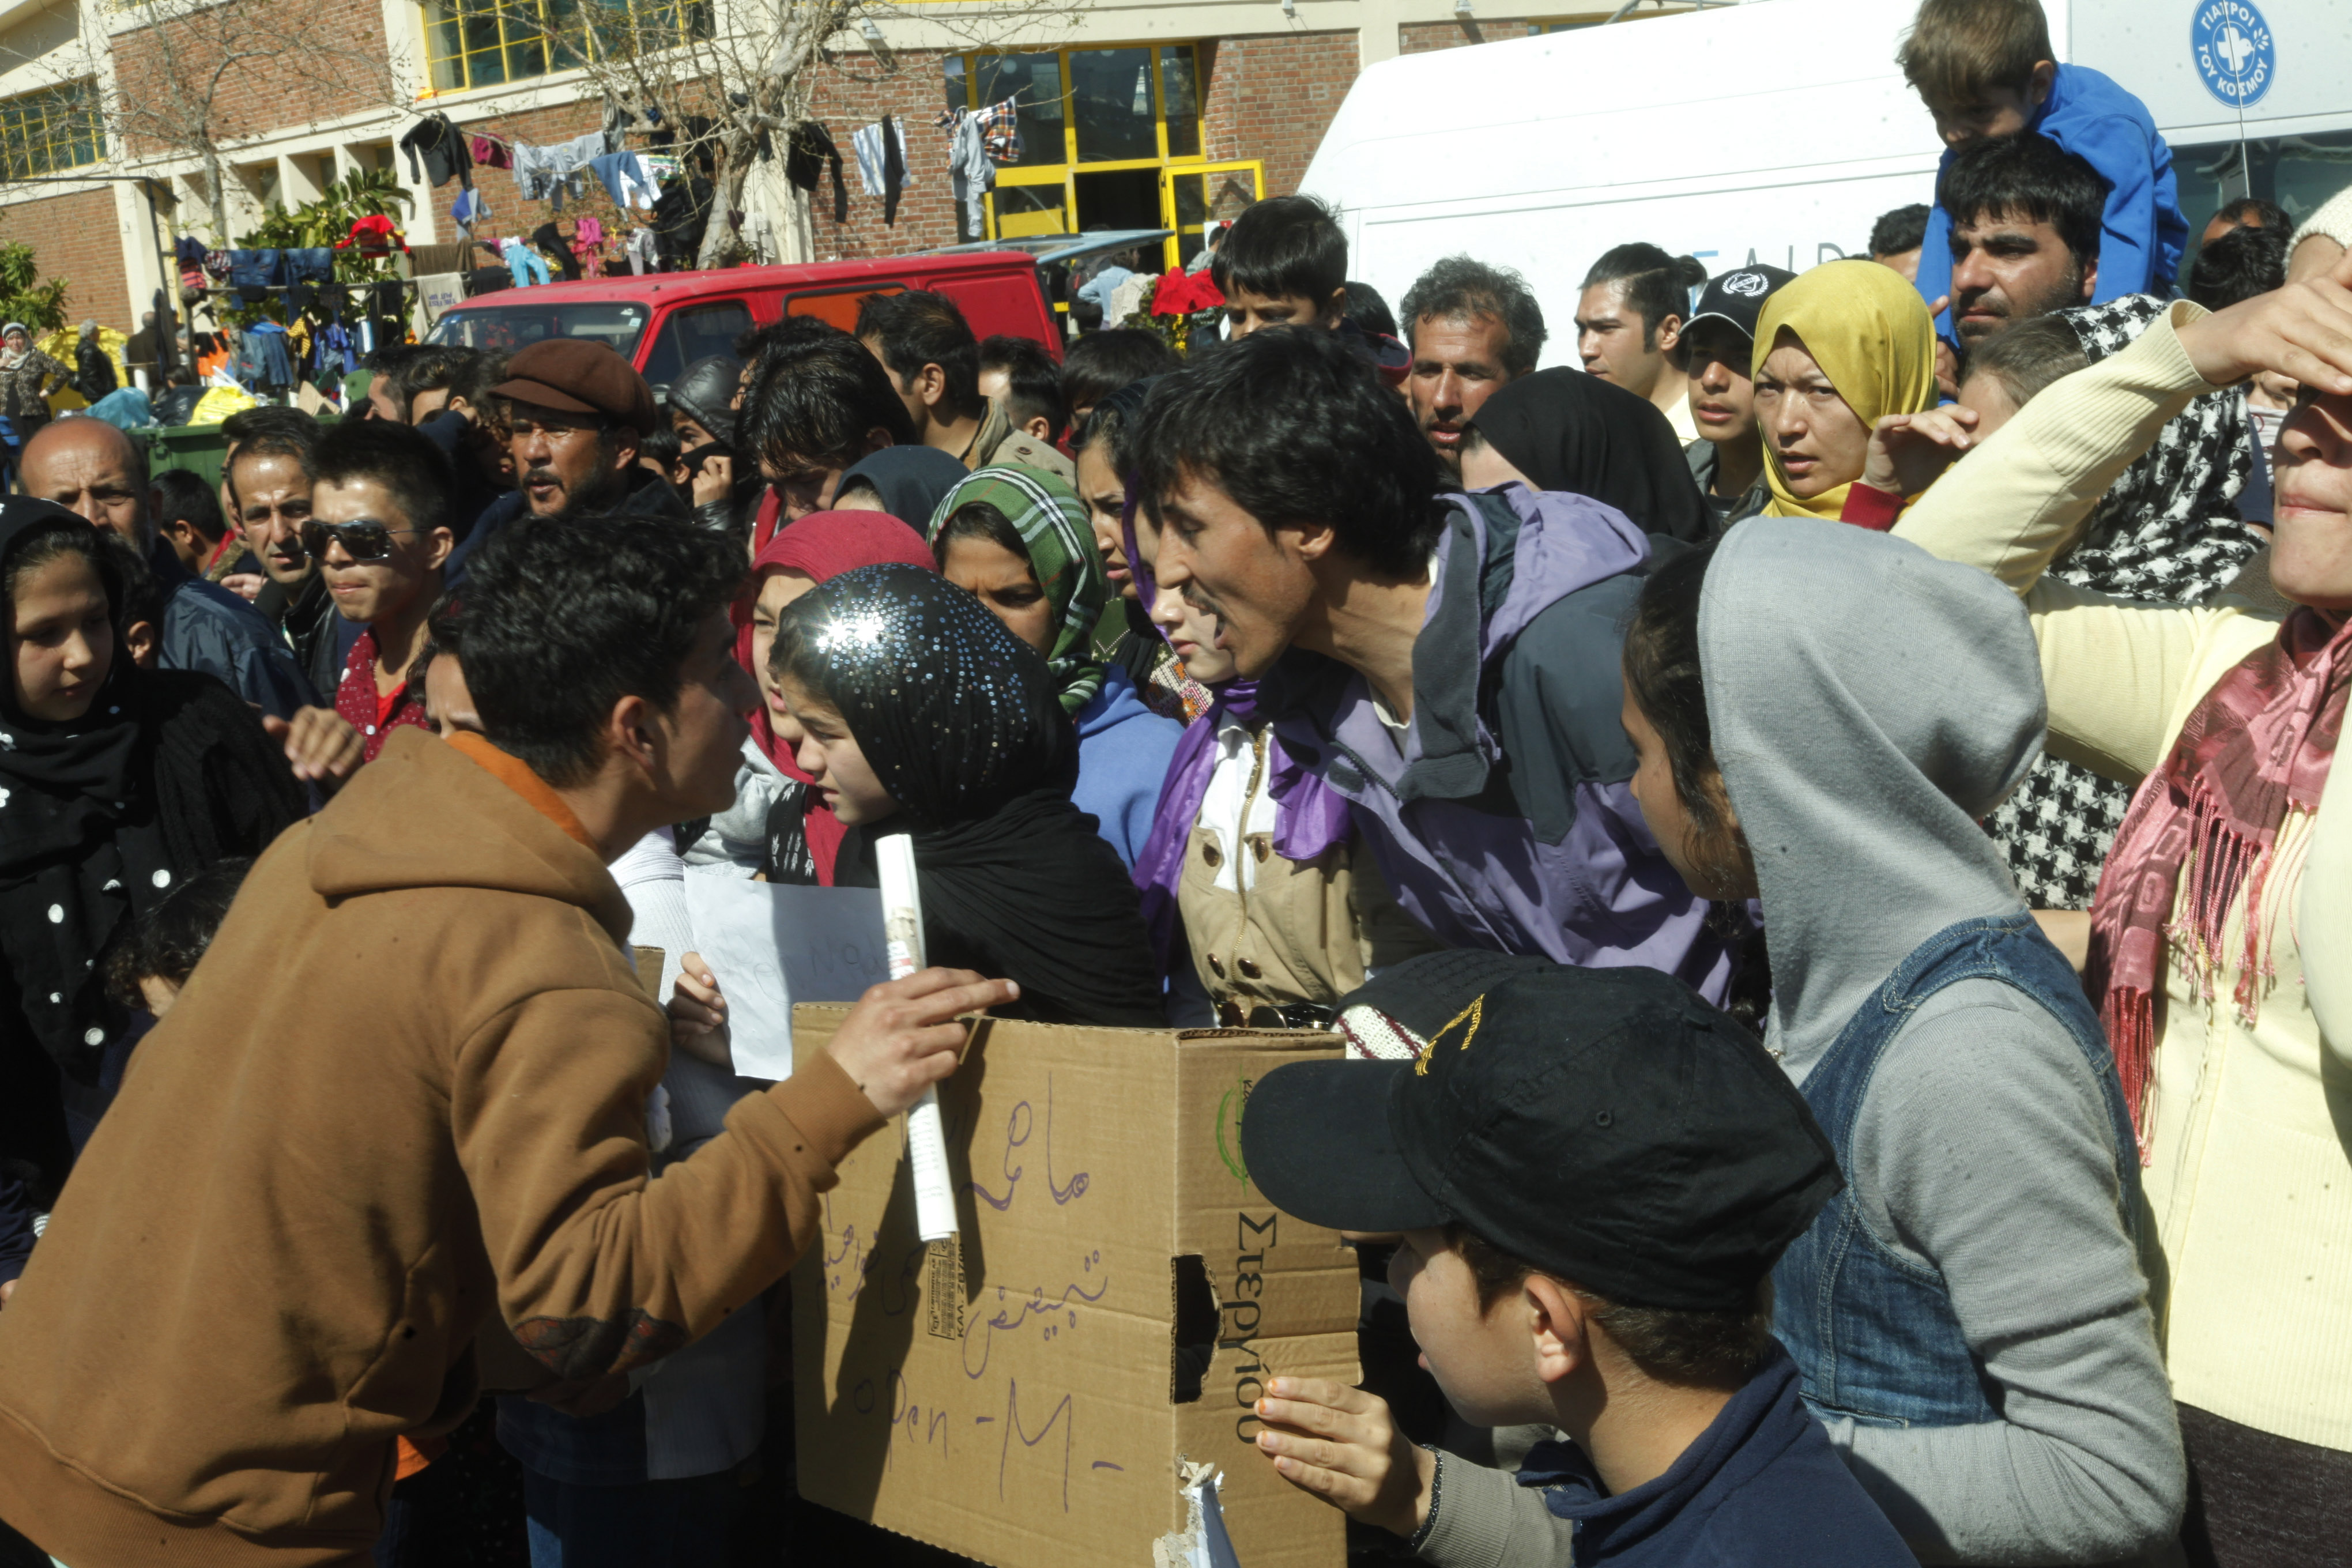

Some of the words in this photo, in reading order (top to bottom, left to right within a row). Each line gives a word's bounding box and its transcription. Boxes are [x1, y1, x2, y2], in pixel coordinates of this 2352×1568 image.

[2201, 2, 2255, 30] ΓΙΑΤΡΟΙ
[2198, 44, 2218, 78] ΤΟΥ
[2217, 58, 2268, 97] ΚΟΣΜΟΥ
